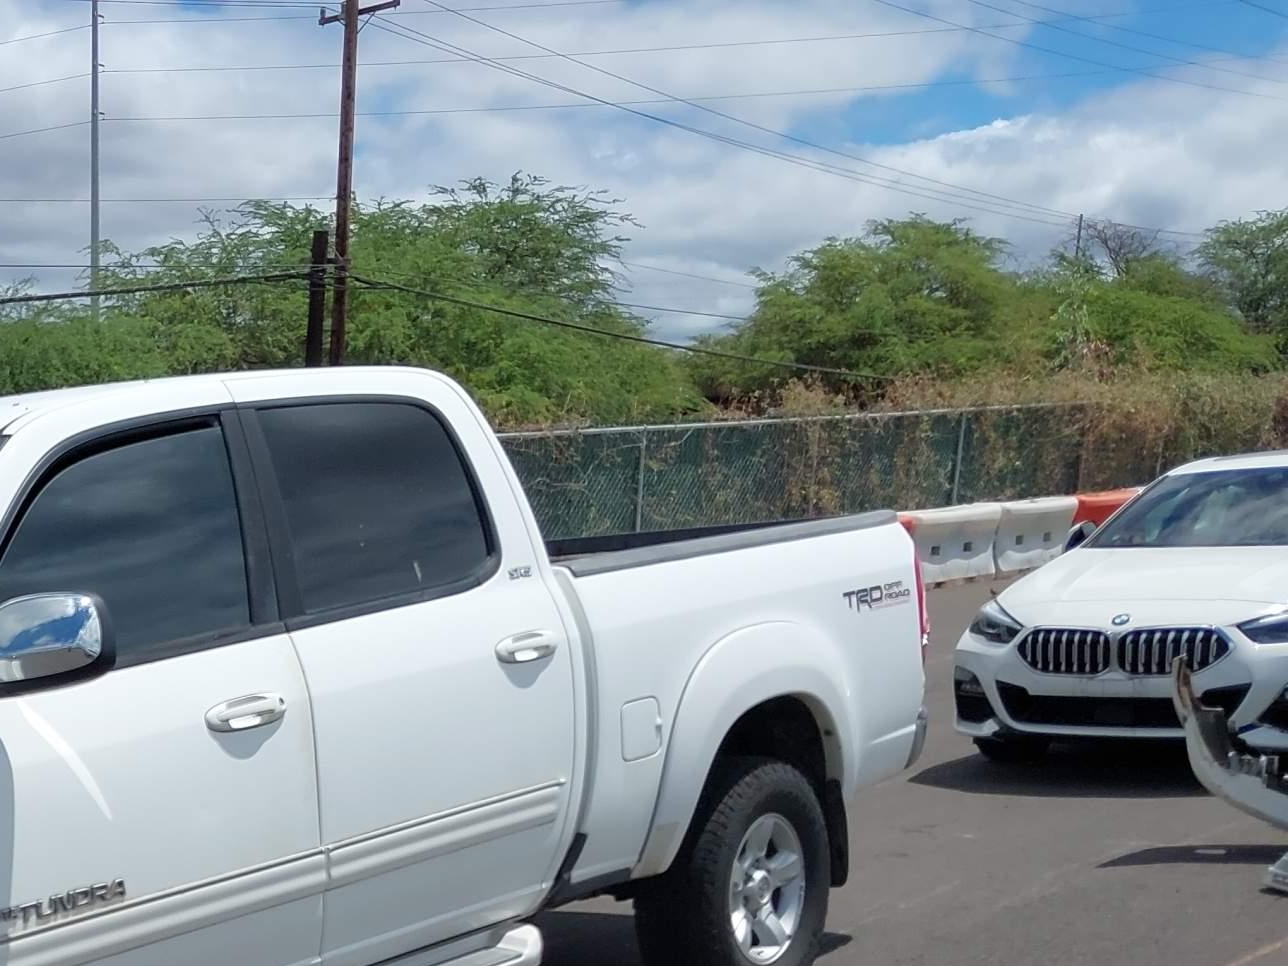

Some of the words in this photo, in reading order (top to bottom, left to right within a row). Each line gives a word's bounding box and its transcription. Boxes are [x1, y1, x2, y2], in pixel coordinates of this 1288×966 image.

[842, 585, 883, 612] TRD
[883, 580, 903, 591] OFF
[884, 588, 910, 600] ROAD
[16, 878, 127, 924] TUNDRA
